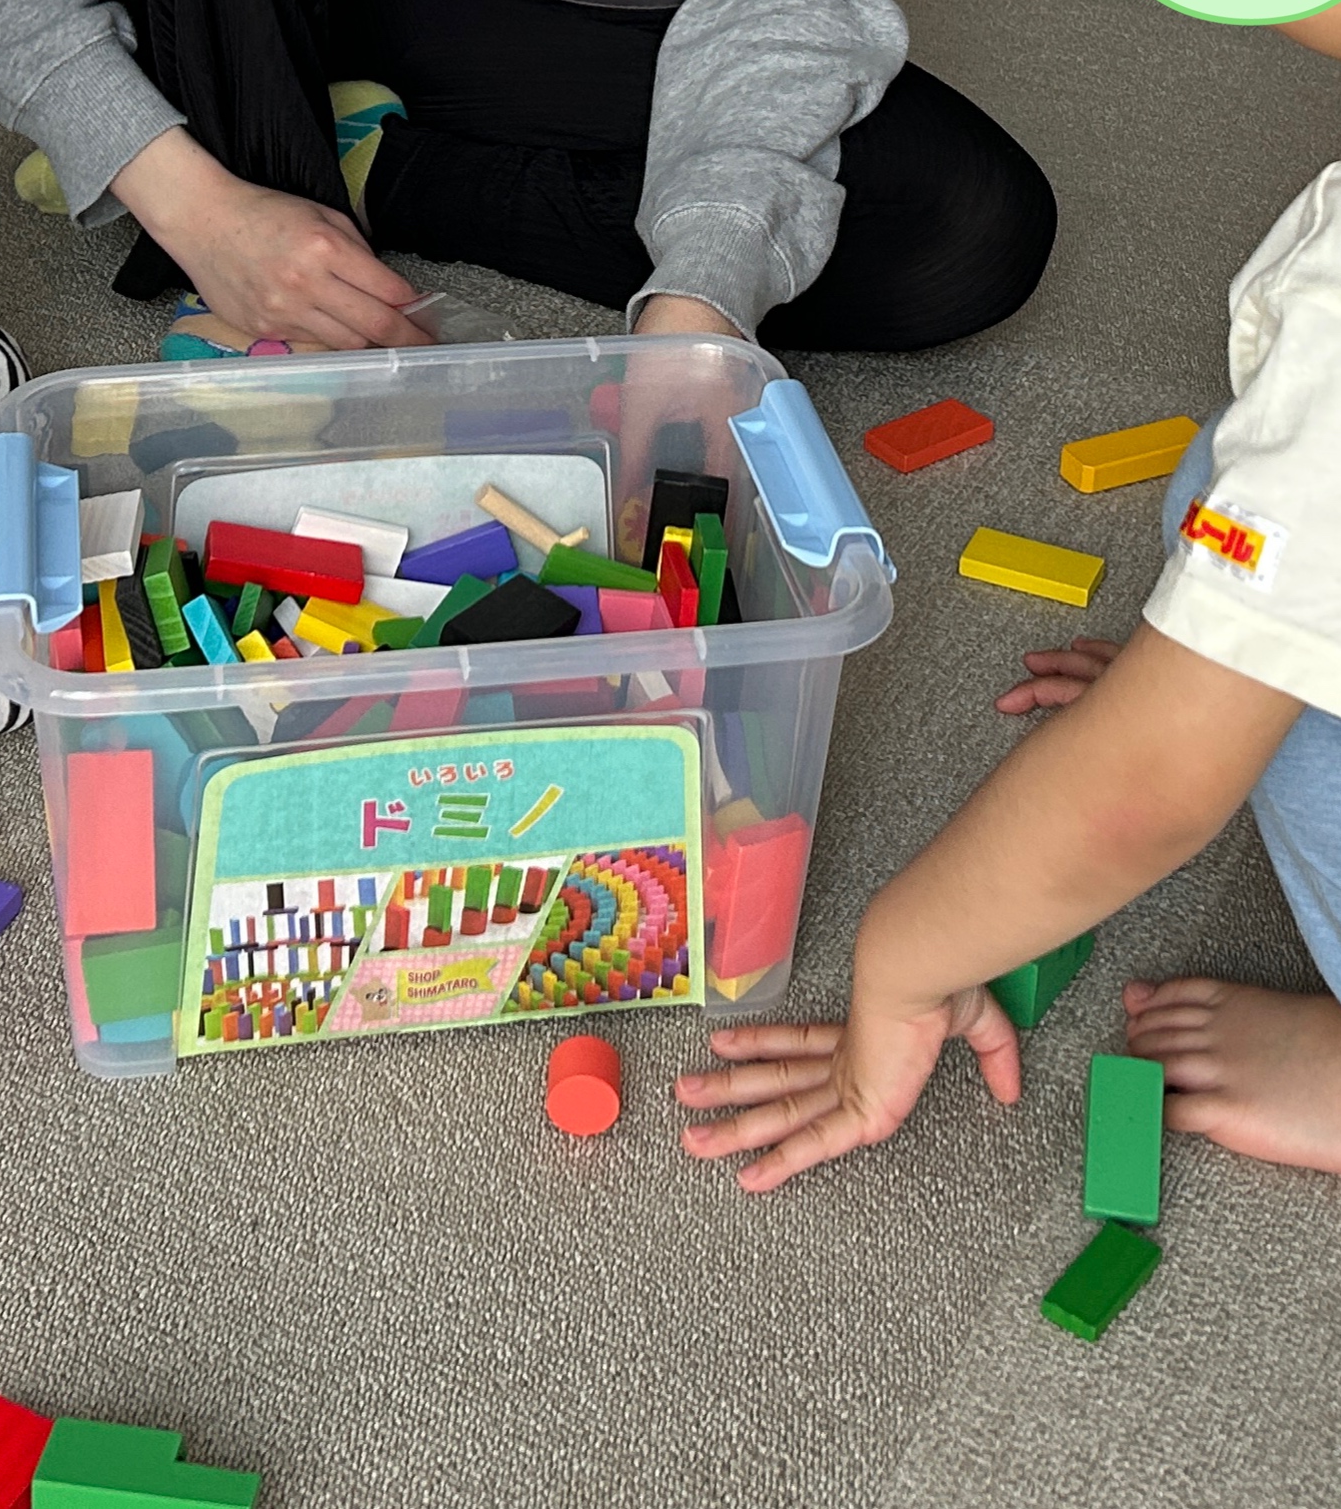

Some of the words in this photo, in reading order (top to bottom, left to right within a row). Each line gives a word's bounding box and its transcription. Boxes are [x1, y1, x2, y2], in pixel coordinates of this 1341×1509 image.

[409, 759, 515, 787] いろいろ
[361, 783, 565, 850] ドミノ
[407, 969, 441, 983] SHOP
[407, 977, 478, 998] SHIMATARO
